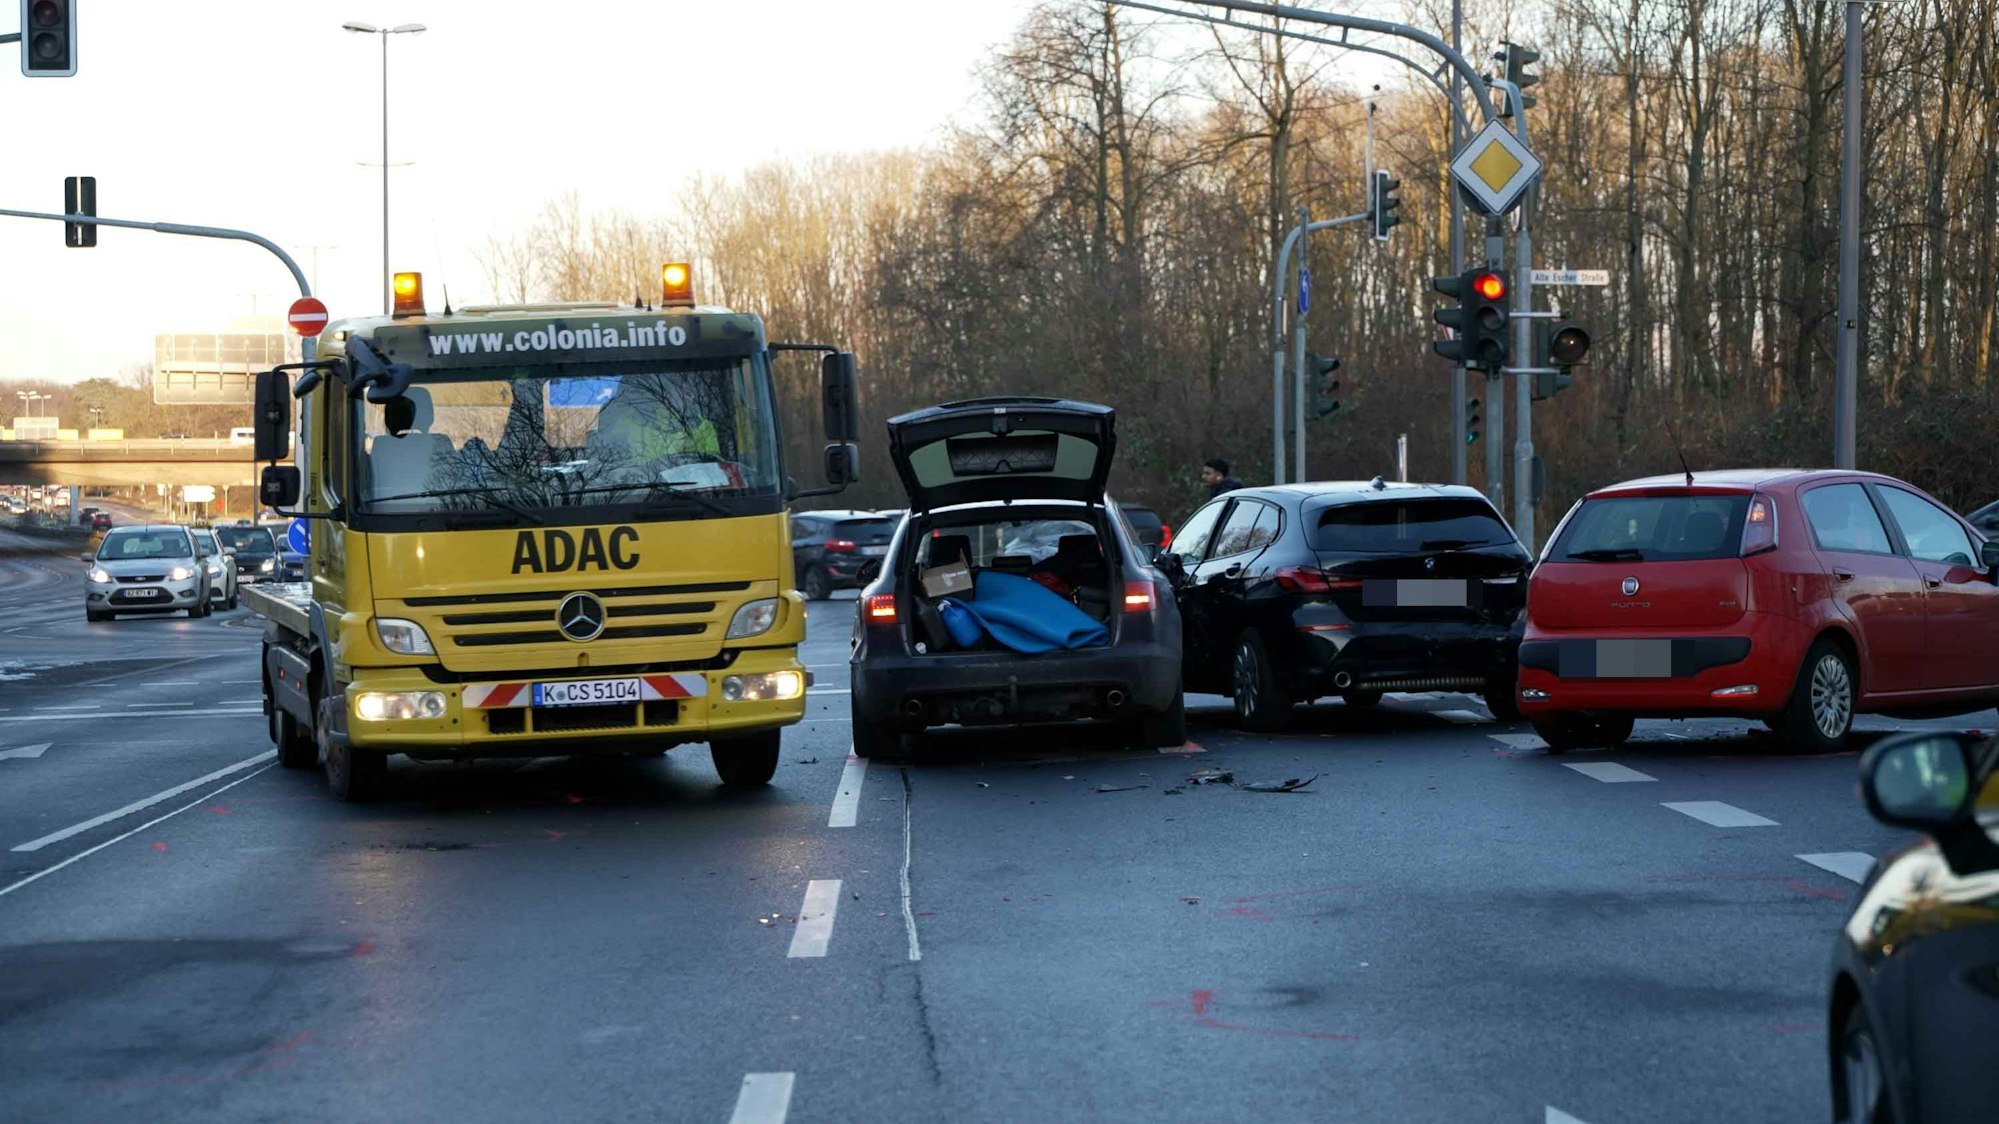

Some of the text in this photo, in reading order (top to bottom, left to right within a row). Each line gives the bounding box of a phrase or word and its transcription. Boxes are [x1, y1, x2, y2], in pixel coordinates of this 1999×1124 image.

[1534, 272, 1549, 281] Alte
[1553, 272, 1577, 281] Escher
[429, 320, 686, 355] www.colonia.info
[511, 526, 640, 574] ADAC
[594, 681, 637, 699] 5104
